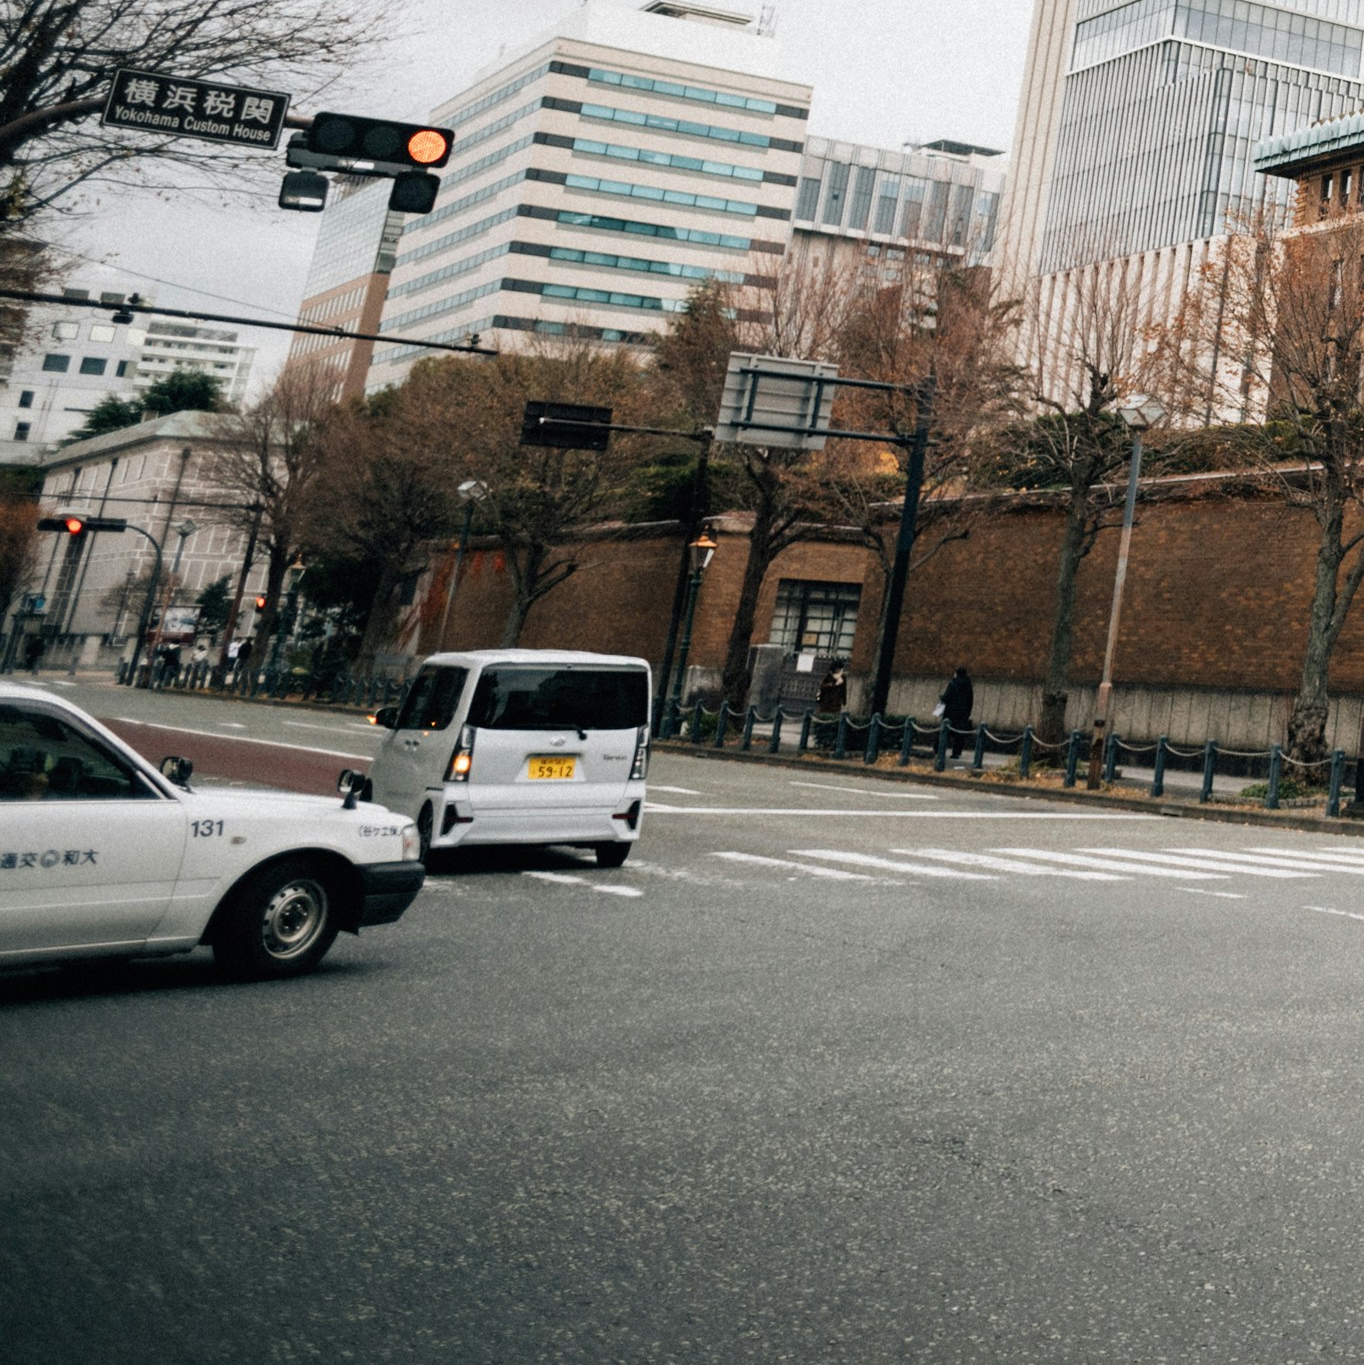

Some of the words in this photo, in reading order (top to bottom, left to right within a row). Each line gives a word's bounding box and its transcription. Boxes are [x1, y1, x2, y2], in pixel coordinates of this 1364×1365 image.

[124, 78, 274, 124] 横浜税関
[115, 105, 180, 128] Yokohama
[183, 116, 230, 135] Custom
[233, 123, 271, 141] House
[538, 766, 573, 777] 59-12
[191, 820, 224, 837] 131
